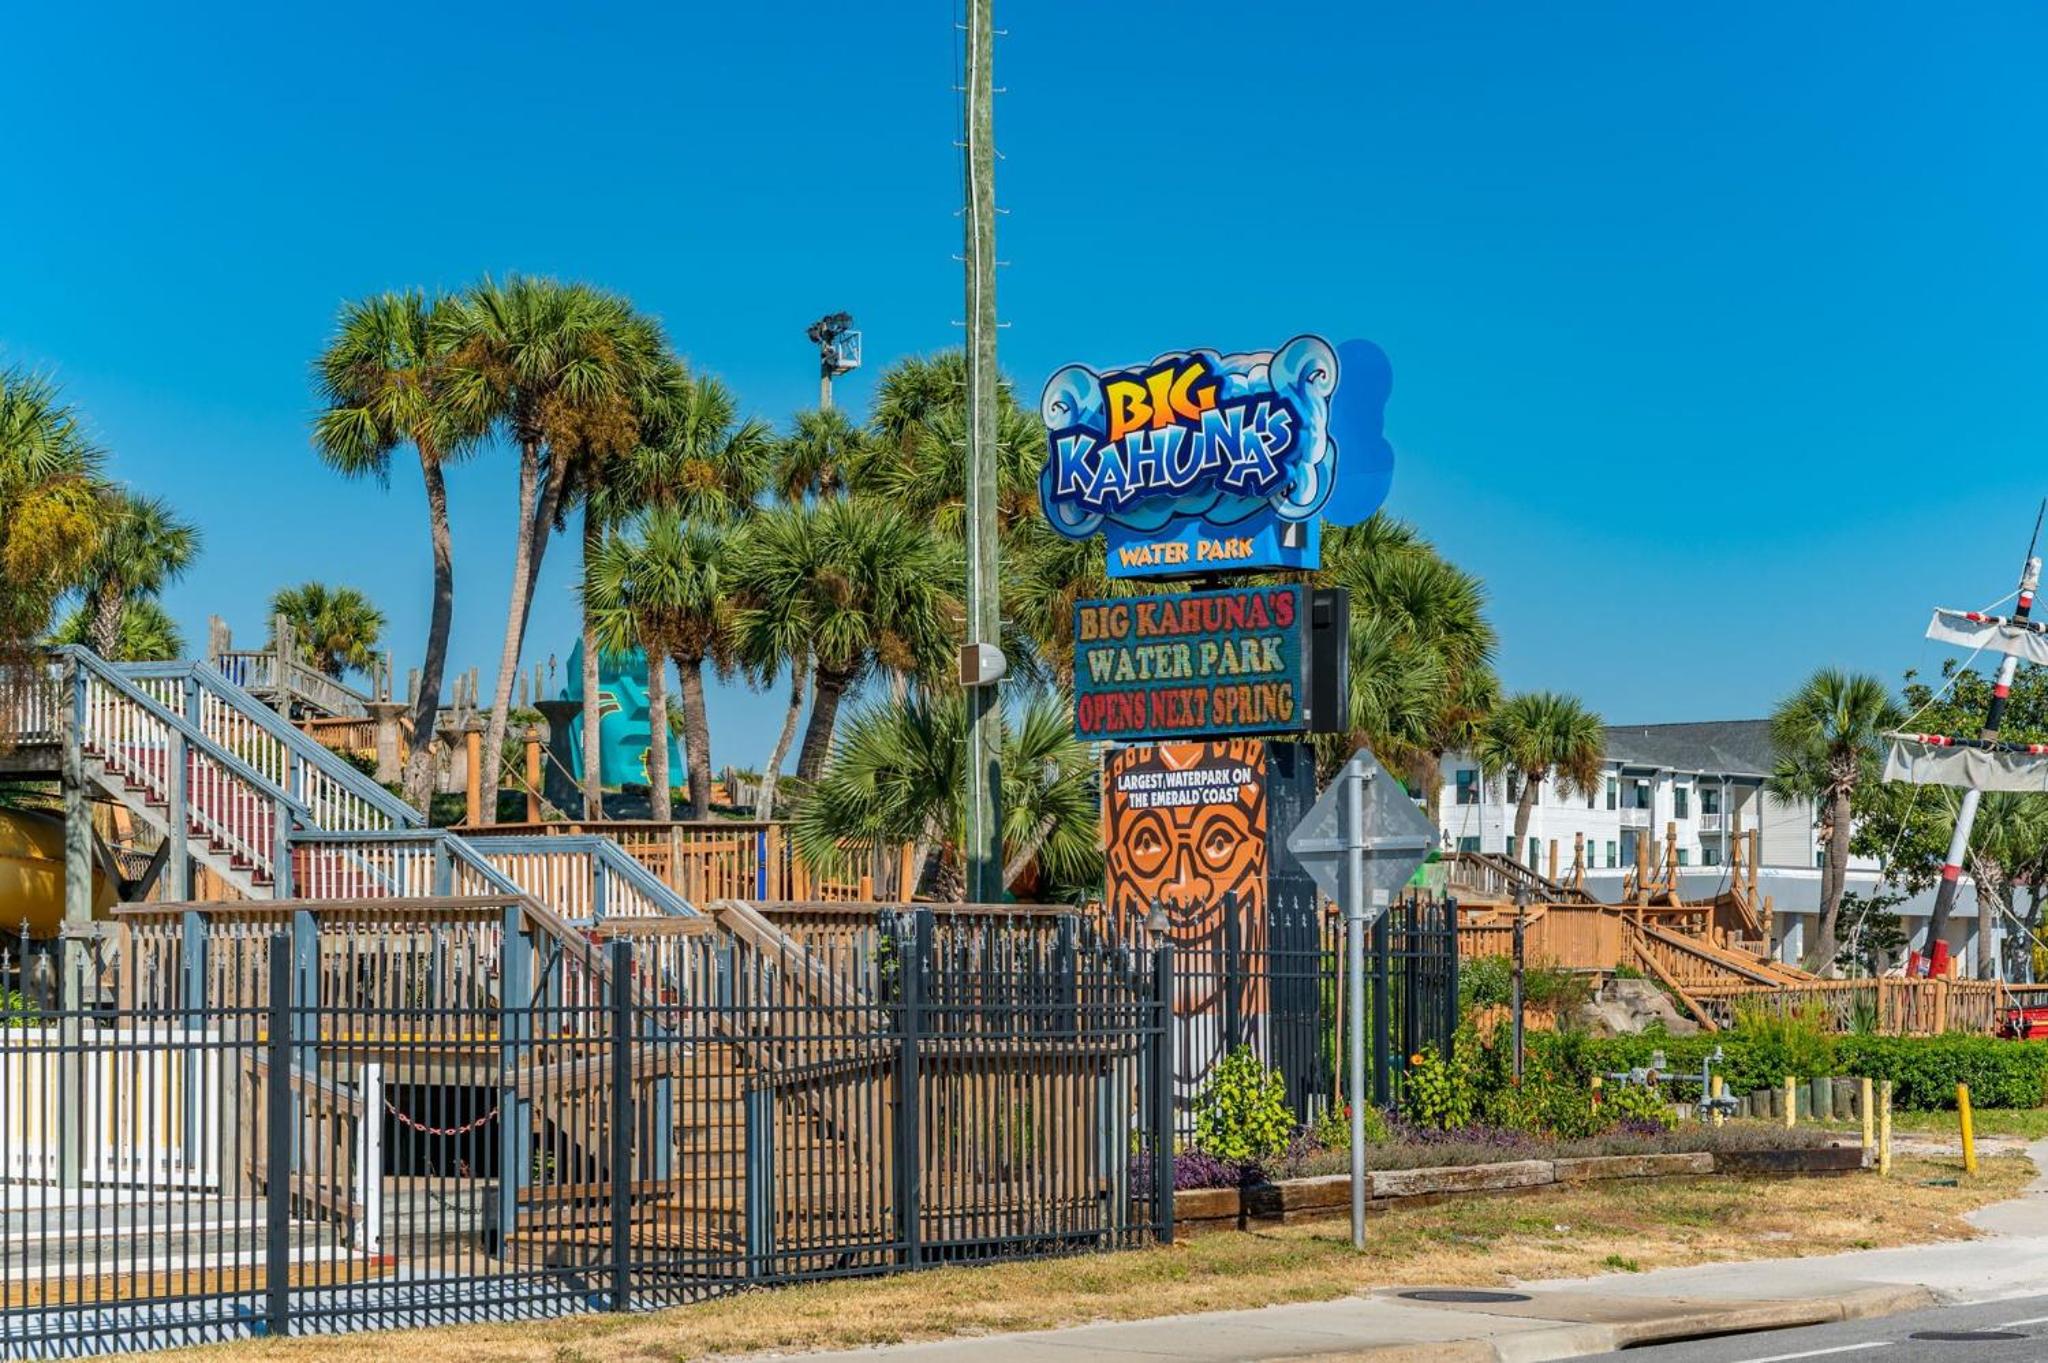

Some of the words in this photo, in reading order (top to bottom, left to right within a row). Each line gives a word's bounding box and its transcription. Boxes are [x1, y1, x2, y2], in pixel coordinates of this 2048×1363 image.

[1107, 363, 1217, 441] BIG
[1057, 402, 1293, 504] KAHUNA'S
[1119, 542, 1190, 568] WATER
[1197, 537, 1254, 561] PARK
[1080, 605, 1129, 640] BIG
[1136, 592, 1294, 636] KAHUNA'S
[1087, 643, 1193, 683] WATER
[1199, 637, 1285, 677] PARK
[1079, 693, 1146, 732] OPENS
[1151, 687, 1208, 728] NEXT
[1212, 683, 1294, 725] SPRING
[1118, 773, 1163, 791] LARGEST
[1165, 769, 1230, 787] WATERPARK
[1233, 767, 1251, 783] ON
[1128, 794, 1149, 808] THE
[1151, 791, 1200, 807] EMERALD
[1202, 787, 1239, 804] COAST
